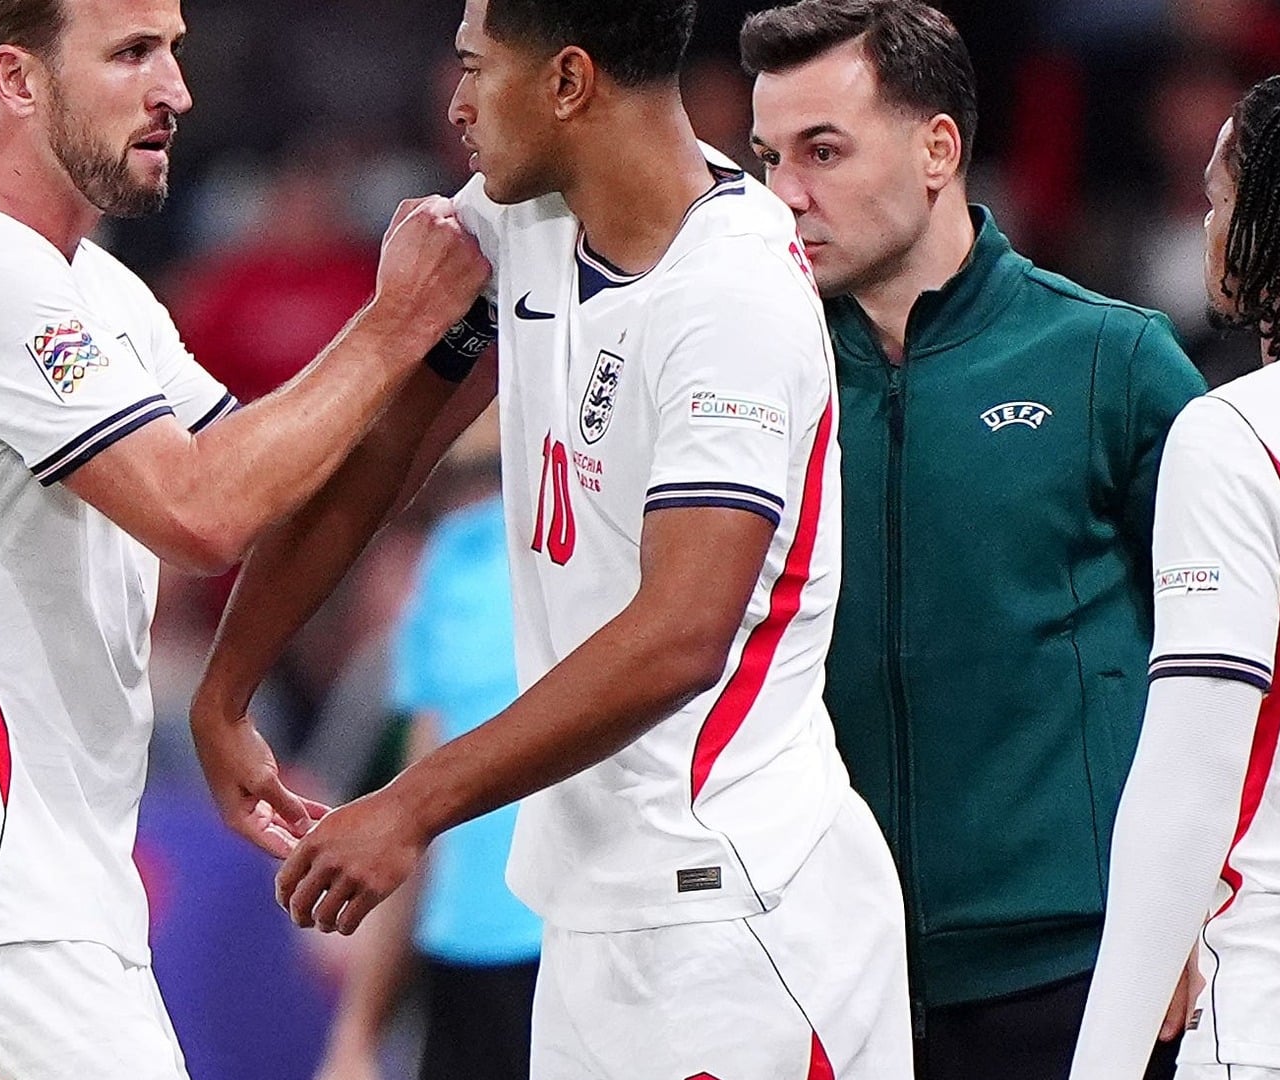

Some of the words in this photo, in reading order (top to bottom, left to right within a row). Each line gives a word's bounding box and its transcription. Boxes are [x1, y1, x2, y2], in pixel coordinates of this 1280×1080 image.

[691, 401, 785, 426] FOUNDATION
[983, 404, 1047, 428] UEFA
[531, 428, 576, 566] 10
